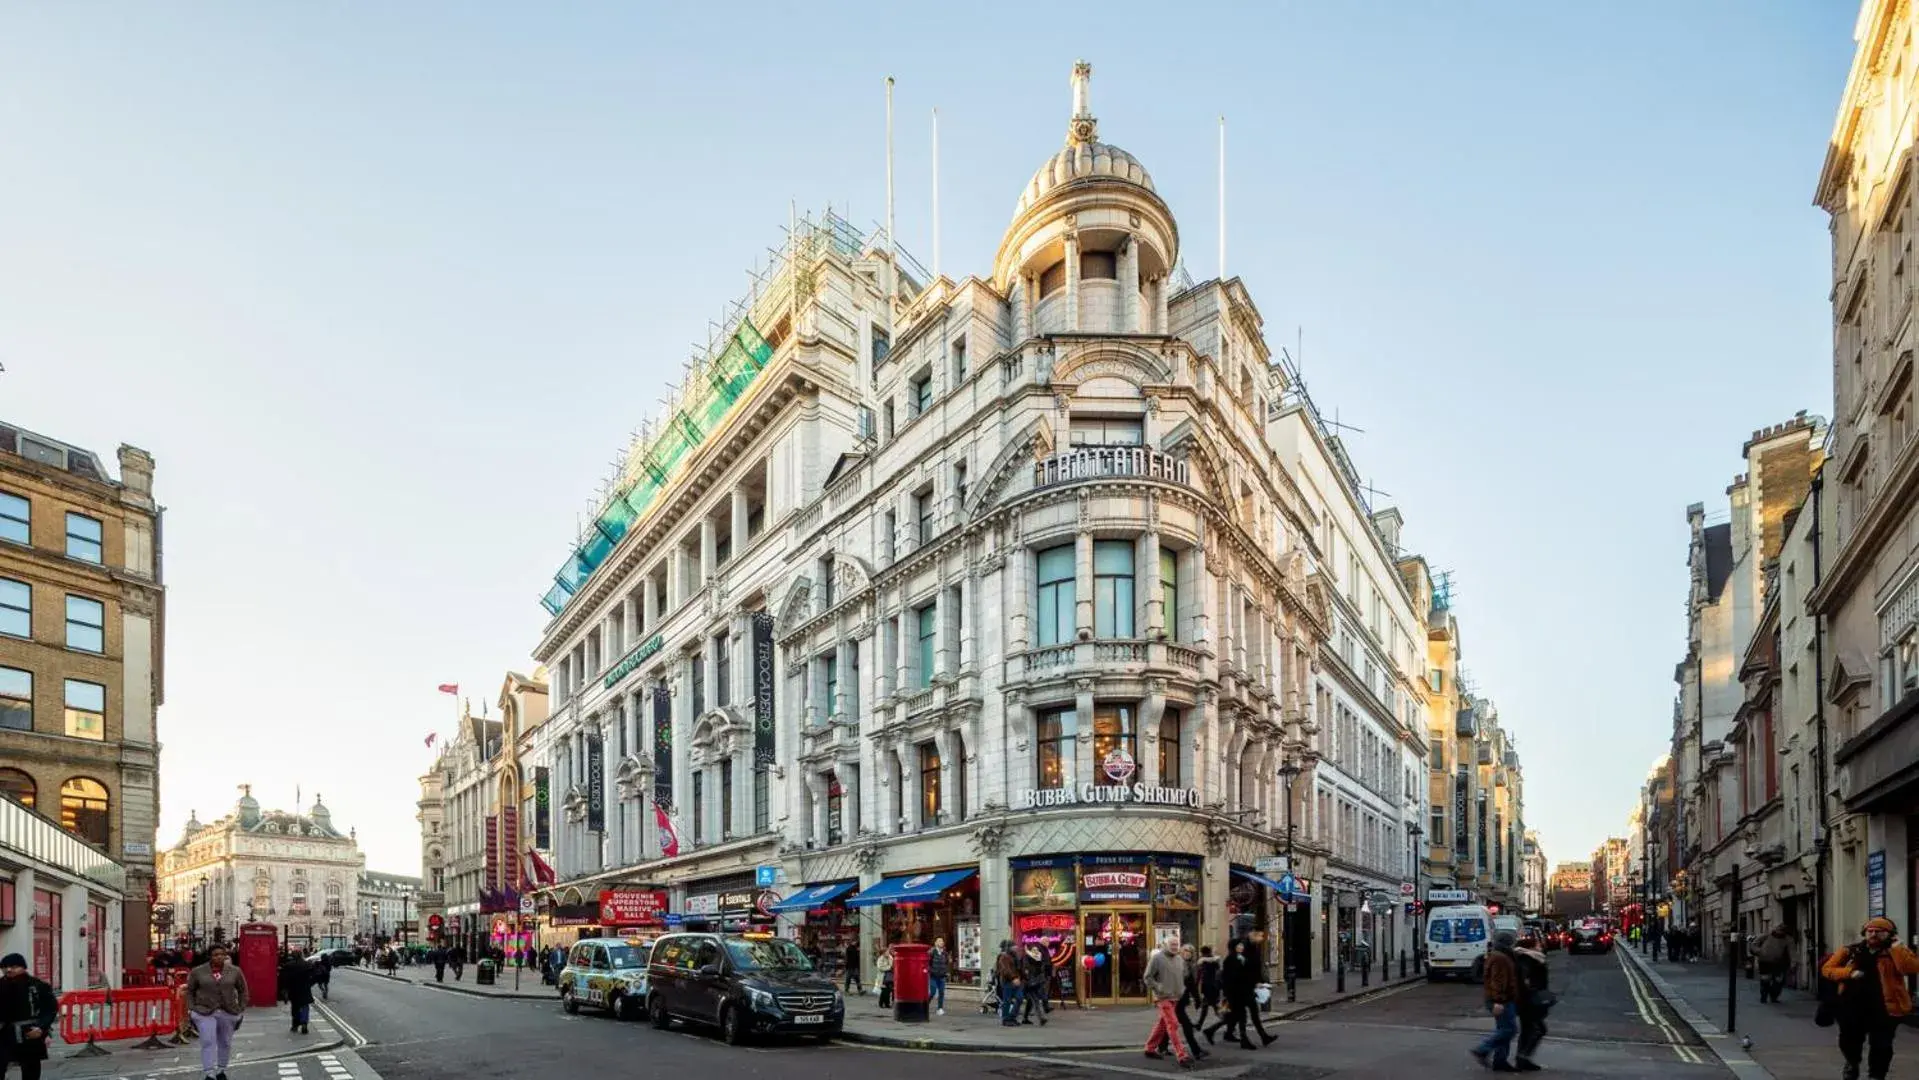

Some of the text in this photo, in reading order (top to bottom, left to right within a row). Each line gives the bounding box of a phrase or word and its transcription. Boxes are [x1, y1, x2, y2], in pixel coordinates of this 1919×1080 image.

[759, 642, 772, 731] TROCADERO
[1024, 786, 1077, 808] BUBBA
[1081, 782, 1130, 803] GUMP
[1133, 782, 1187, 806] SHRIMP
[1085, 873, 1145, 886] BUBBA GUMP
